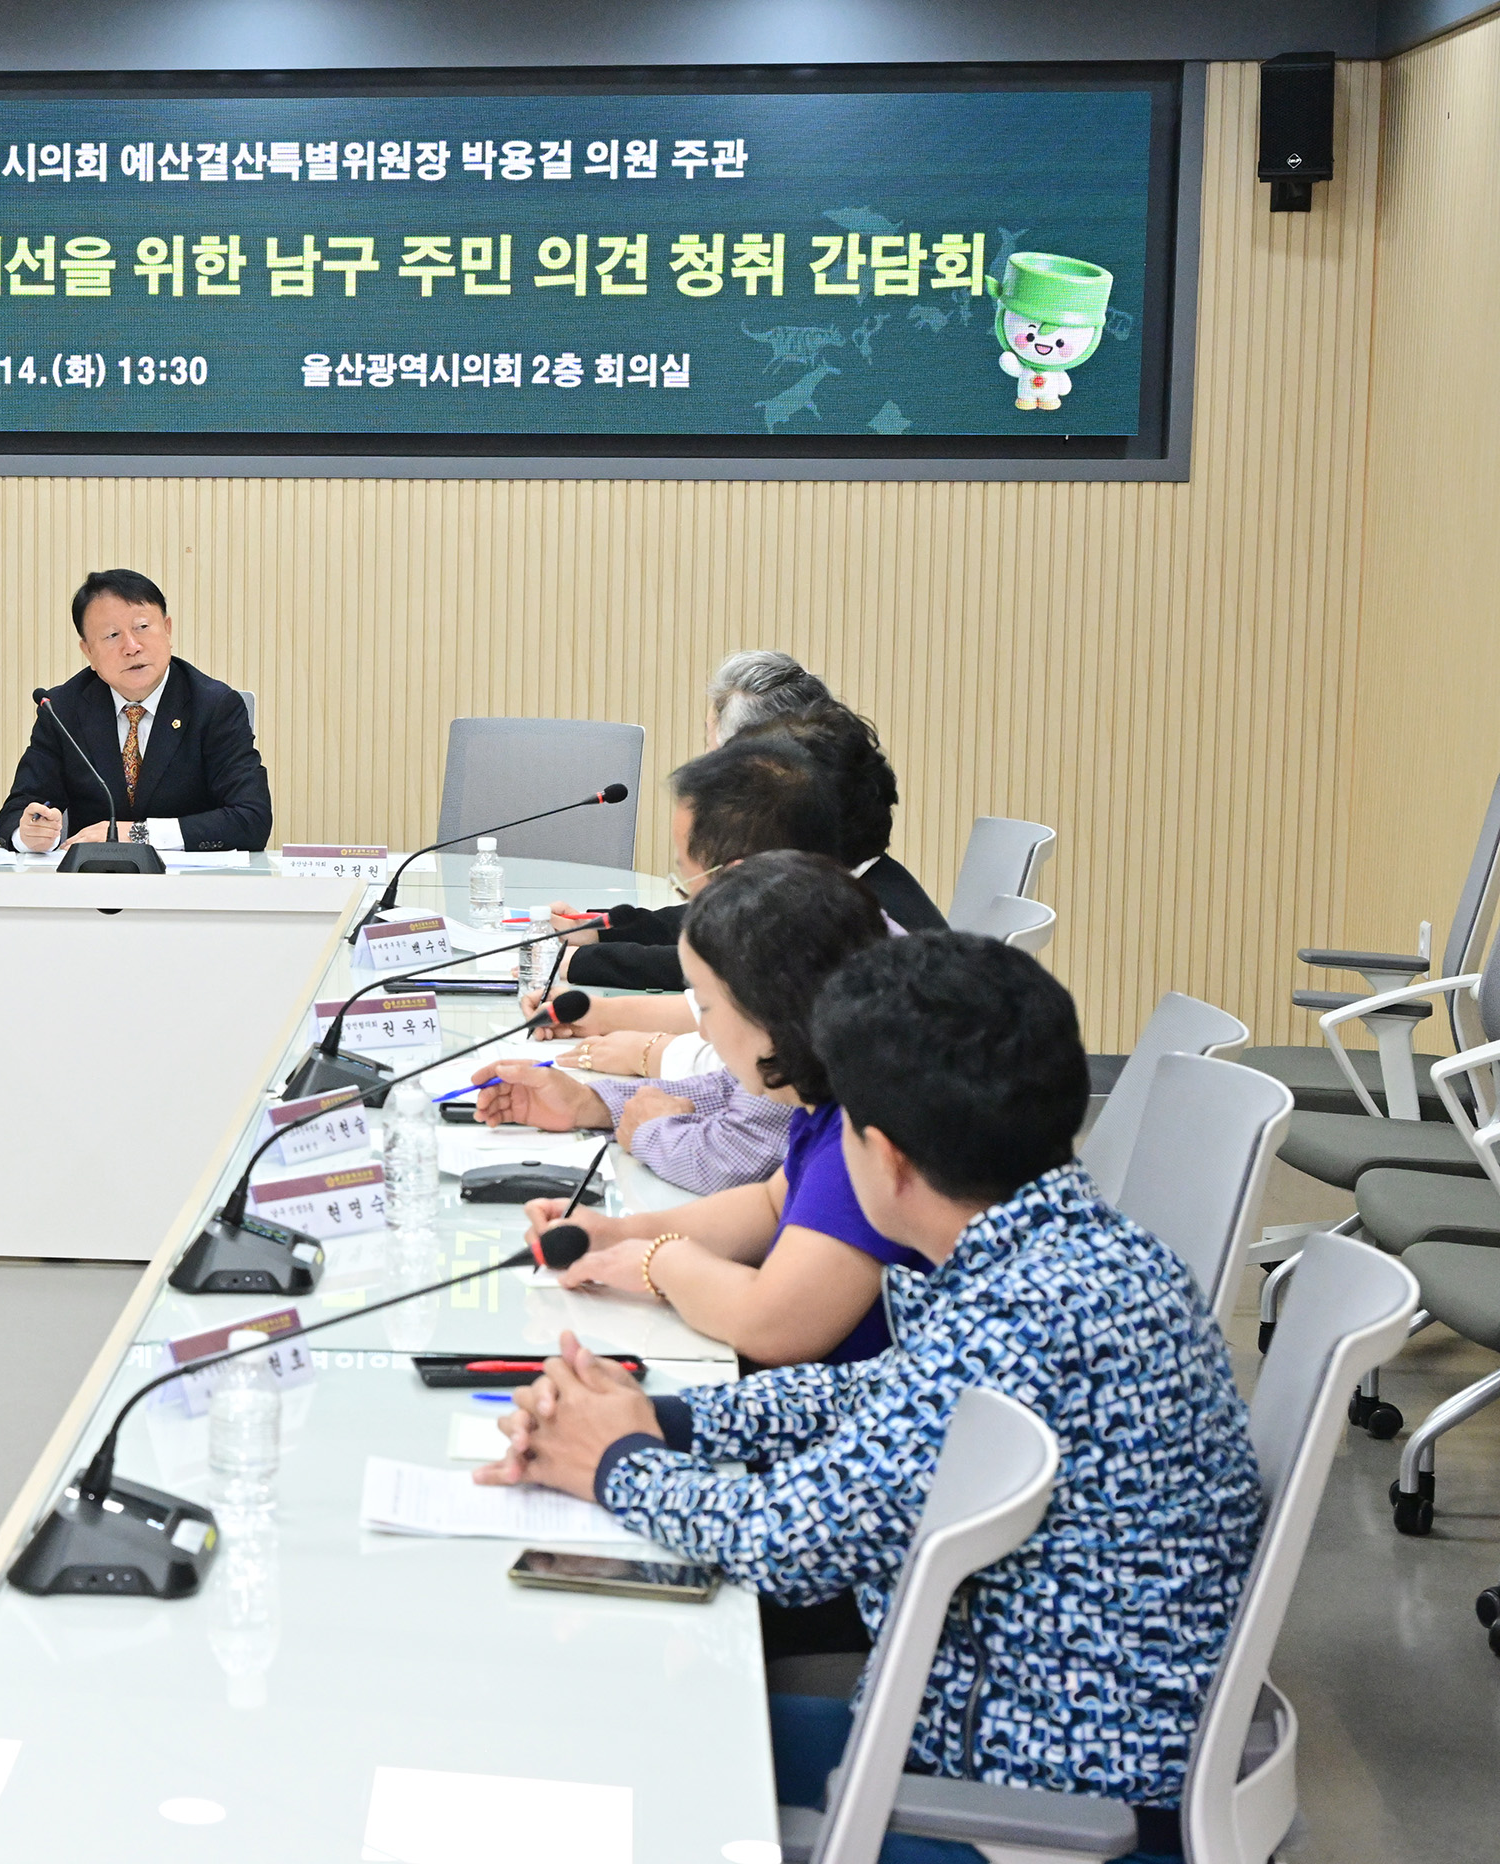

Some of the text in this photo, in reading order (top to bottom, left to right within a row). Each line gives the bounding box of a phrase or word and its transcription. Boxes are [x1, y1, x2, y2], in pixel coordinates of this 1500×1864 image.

[121, 142, 451, 182] 예산결산특별위원장
[463, 141, 573, 181] 박용걸
[585, 140, 659, 180] 의원
[672, 139, 749, 179] 주관
[134, 235, 248, 298] 위한
[267, 235, 381, 298] 남구
[399, 235, 513, 298] 주민
[535, 235, 649, 297] 의견
[670, 234, 786, 298] 청취
[810, 234, 987, 297] 간담회
[0, 354, 107, 389] 14.(화)
[119, 357, 209, 386] 13:30
[301, 353, 692, 389] 울산광역시의회 2층 회의실
[333, 864, 379, 878] 안정원
[411, 937, 448, 956] 백수연
[382, 1017, 437, 1038] 권옥자
